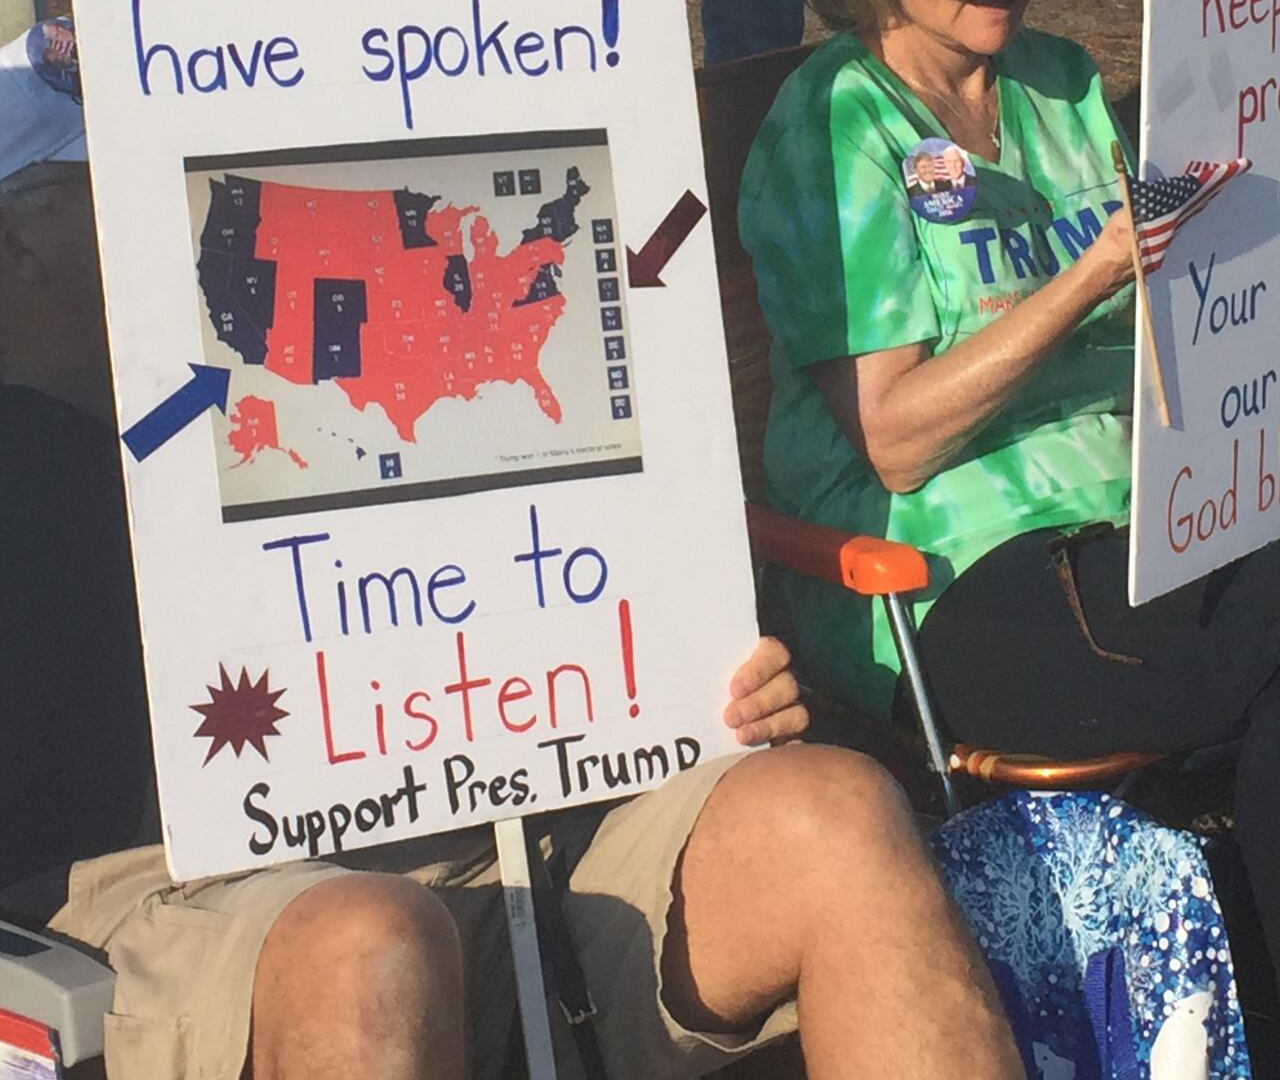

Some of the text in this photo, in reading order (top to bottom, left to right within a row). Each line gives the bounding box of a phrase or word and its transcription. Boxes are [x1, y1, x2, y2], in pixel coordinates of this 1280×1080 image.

[1188, 252, 1267, 346] Your
[1220, 370, 1277, 428] our
[1167, 439, 1239, 554] God
[262, 504, 609, 643] Time to
[315, 598, 641, 766] Listen!
[242, 763, 427, 858] Support
[444, 753, 538, 815] Pres.
